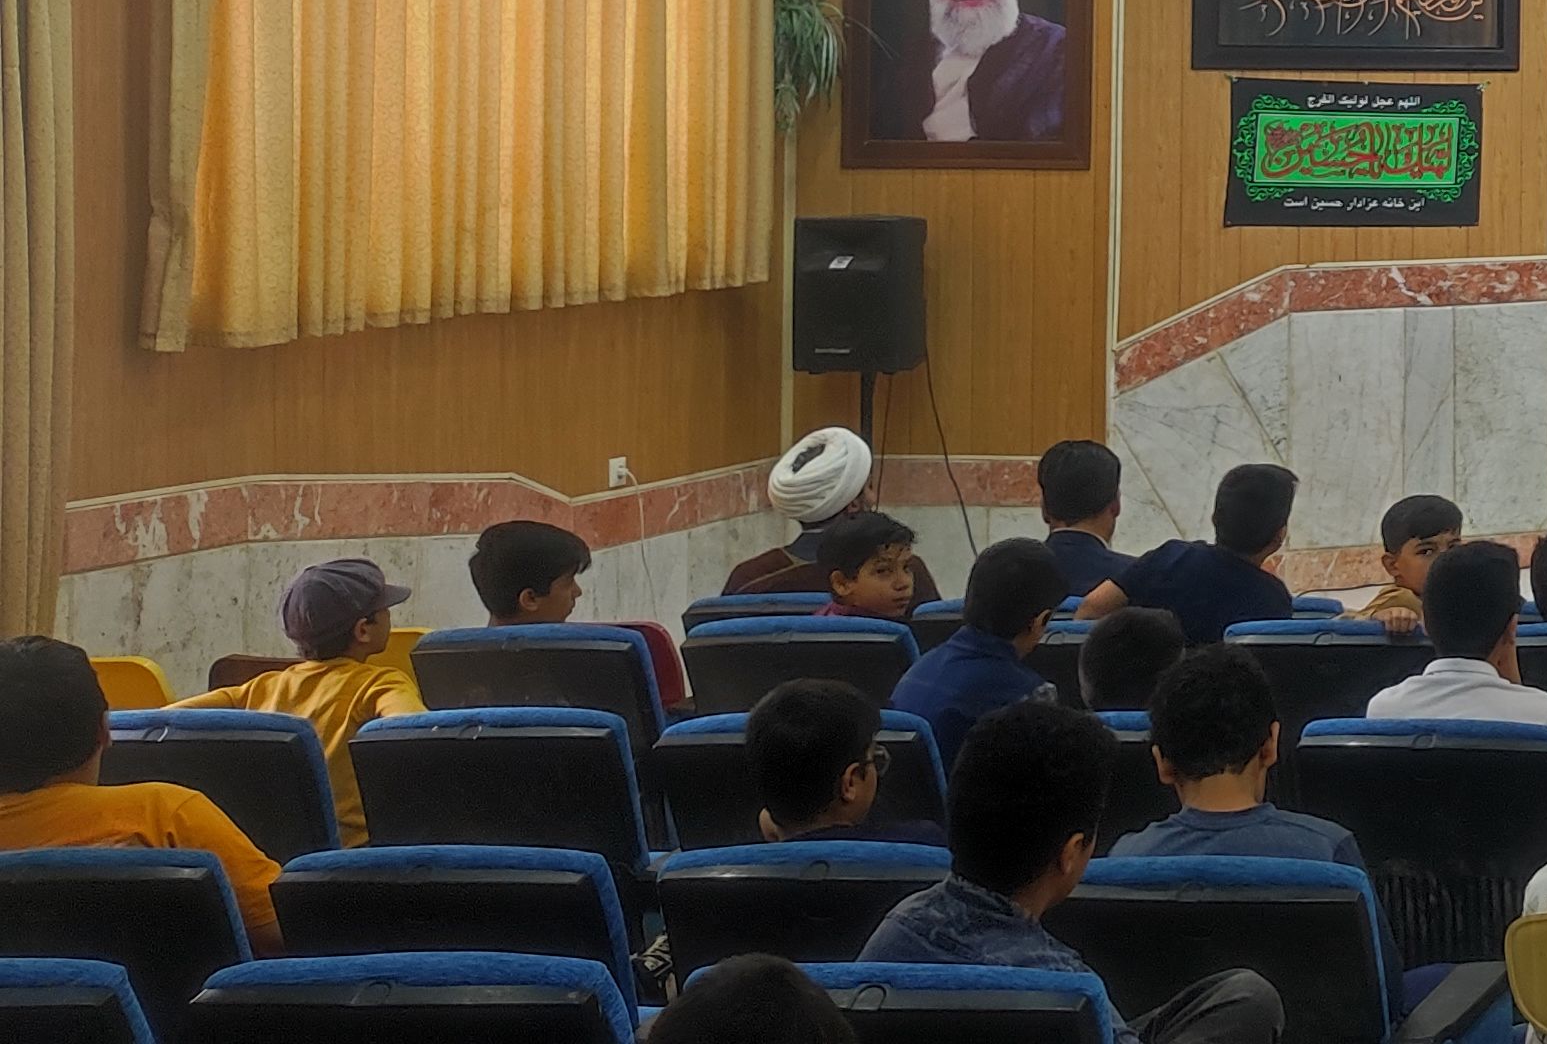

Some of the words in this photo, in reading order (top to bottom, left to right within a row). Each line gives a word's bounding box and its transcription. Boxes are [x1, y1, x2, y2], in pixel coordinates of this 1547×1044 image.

[1307, 94, 1335, 108] الفرج
[1338, 94, 1368, 108] لولیک
[1371, 96, 1394, 108] عجل
[1397, 96, 1420, 110] اللهم
[1283, 196, 1308, 207] است
[1310, 197, 1344, 210] حسین
[1346, 197, 1379, 211] عزادار
[1382, 197, 1405, 208] خانه
[1408, 197, 1426, 211] این
